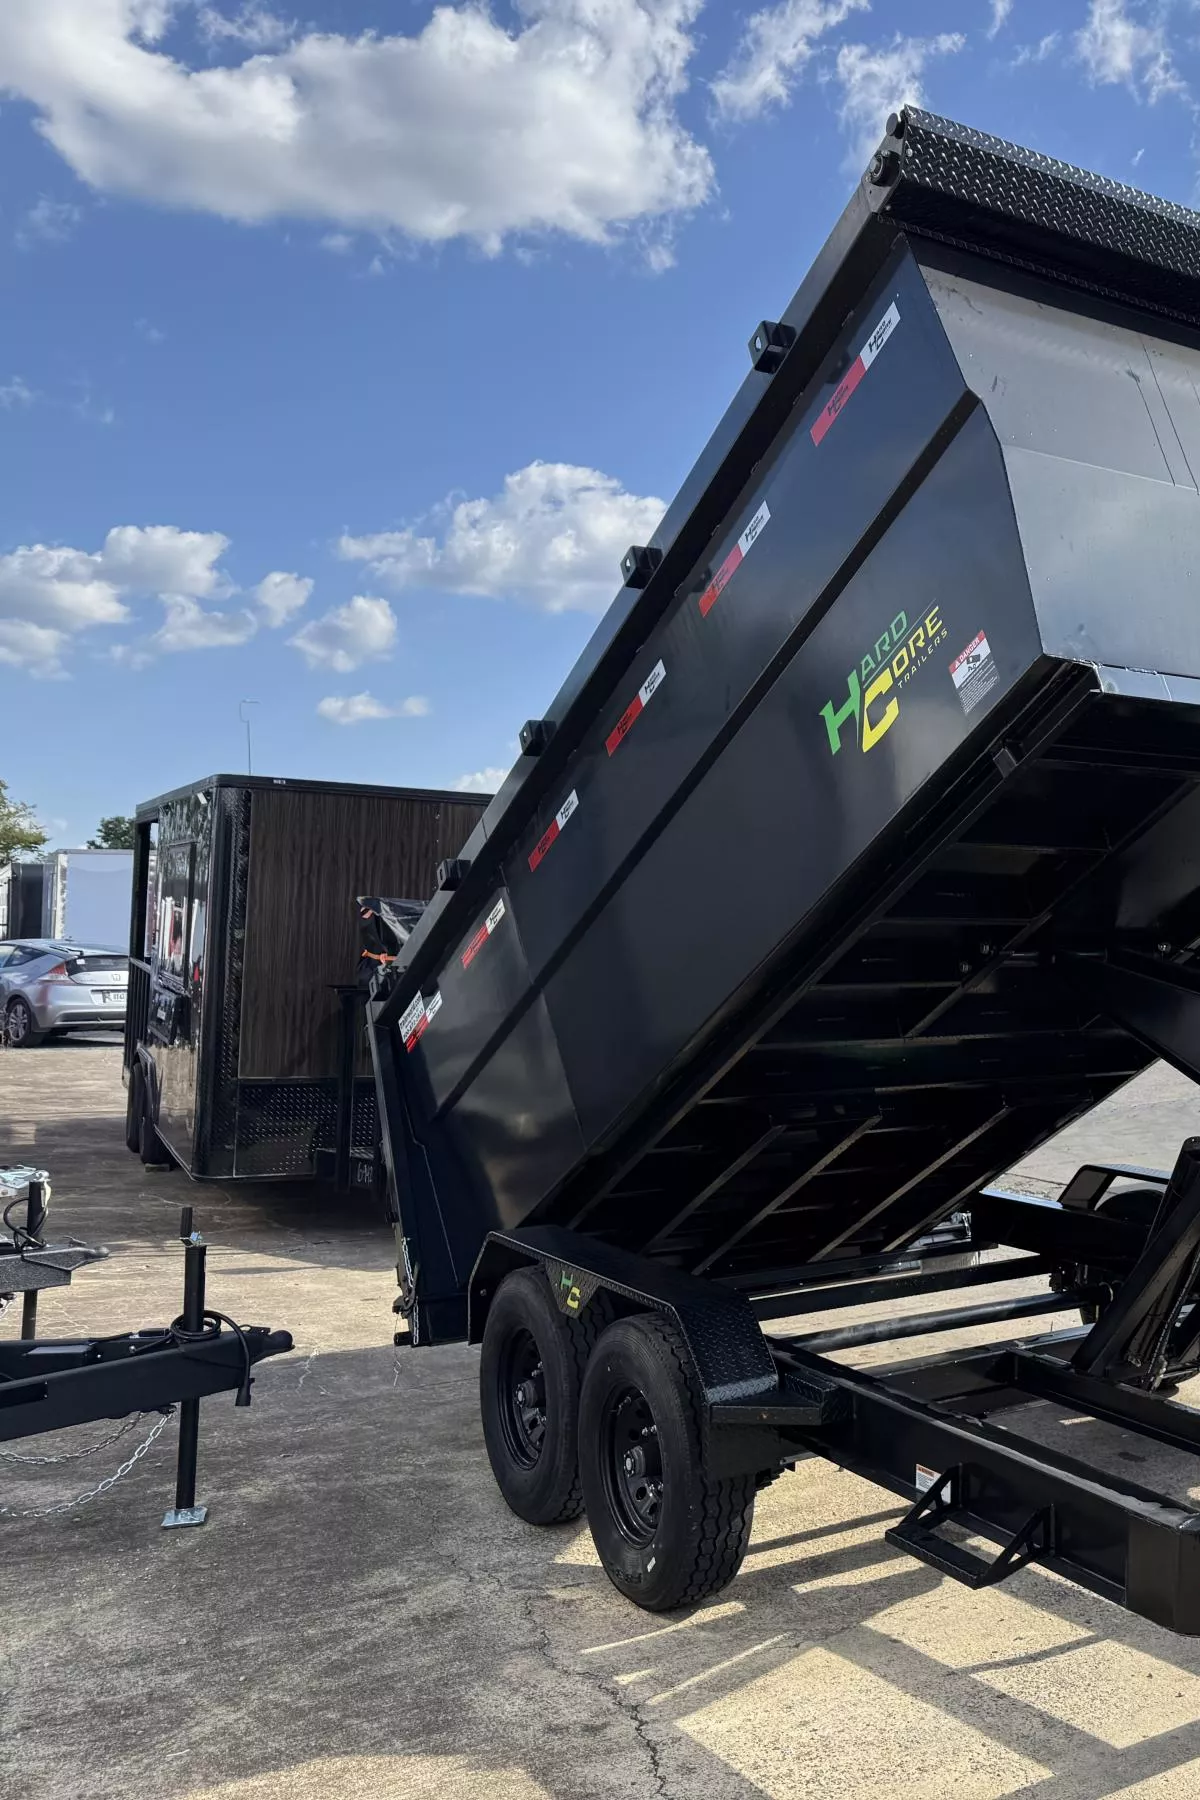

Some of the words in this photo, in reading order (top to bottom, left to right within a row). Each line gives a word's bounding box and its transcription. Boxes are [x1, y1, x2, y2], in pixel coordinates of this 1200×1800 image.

[819, 610, 908, 755] HARD
[862, 606, 943, 753] CORE
[897, 628, 948, 689] TRAILERS
[959, 637, 981, 661] DANGER
